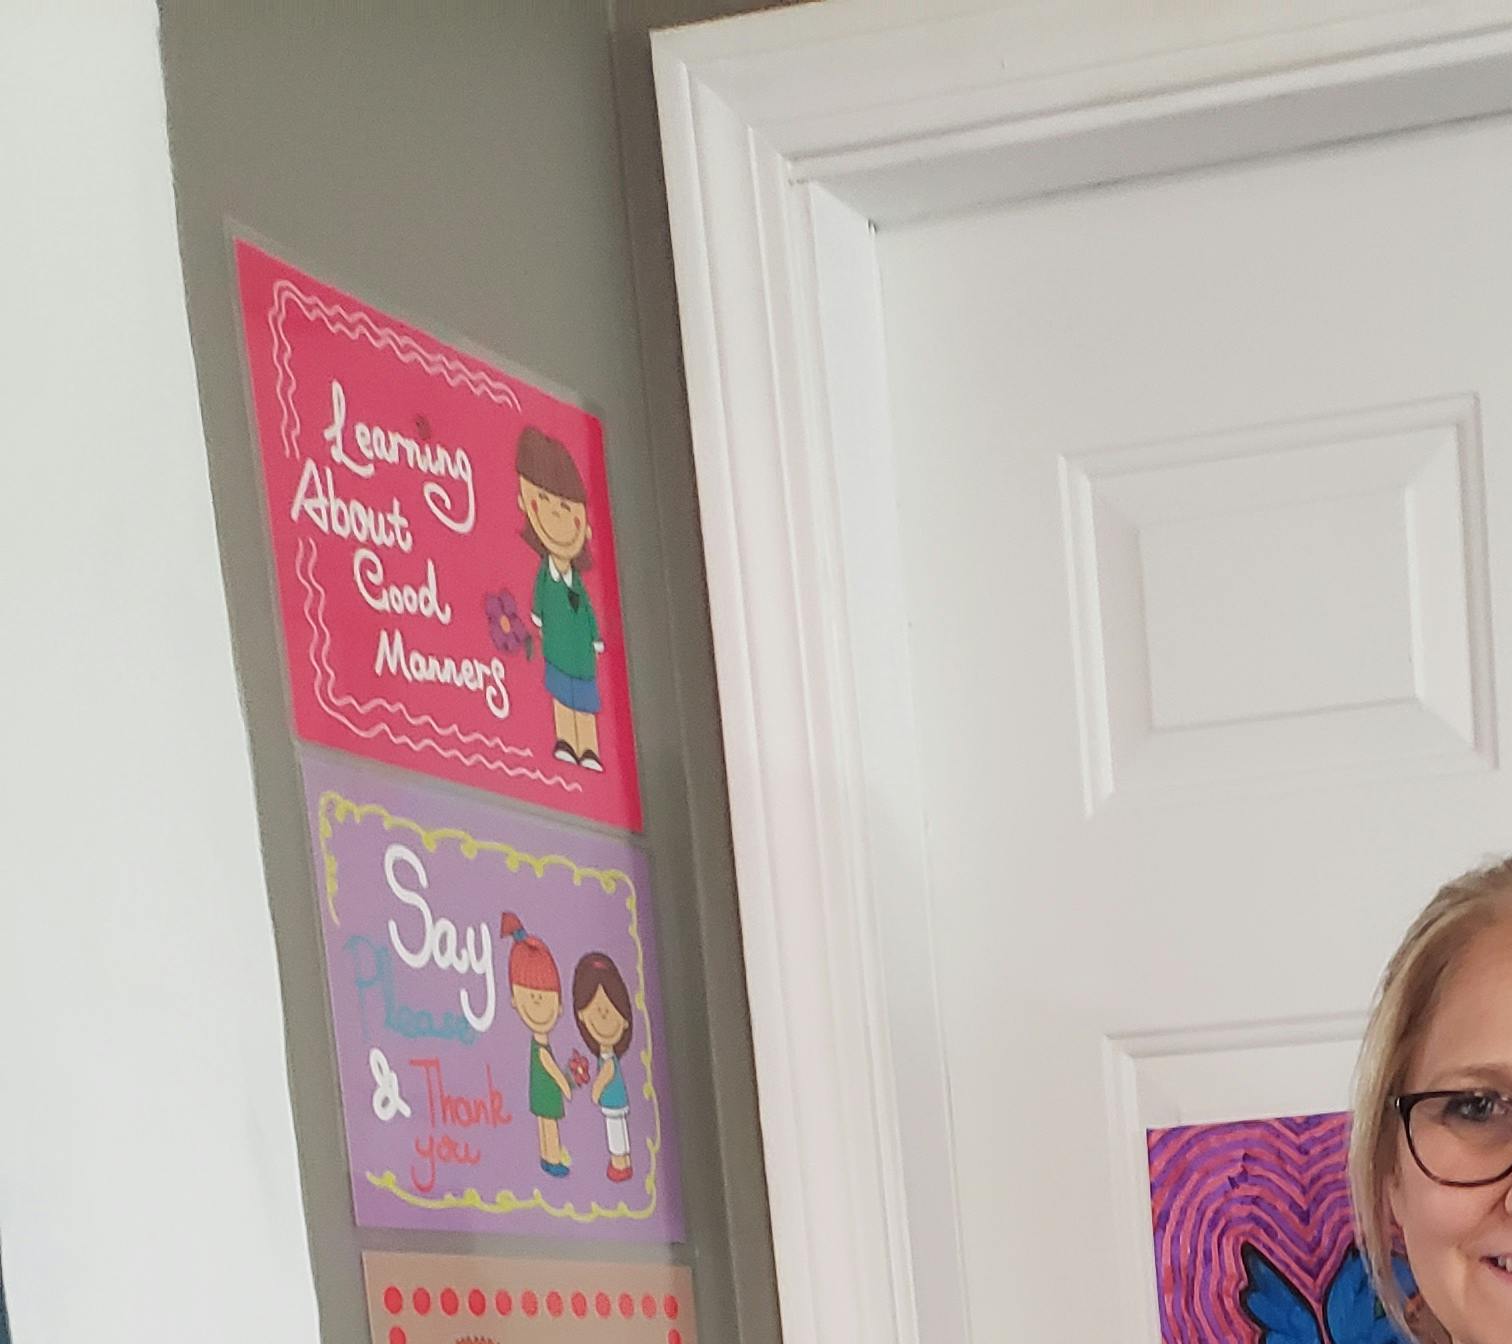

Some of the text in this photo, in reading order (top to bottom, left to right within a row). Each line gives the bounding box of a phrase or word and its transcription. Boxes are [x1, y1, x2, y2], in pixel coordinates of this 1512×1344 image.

[324, 378, 475, 533] Learning
[291, 457, 413, 553] About
[353, 548, 452, 625] Good
[374, 628, 510, 719] Manners
[384, 844, 496, 1032] Say
[368, 1047, 411, 1122] &
[409, 1057, 512, 1130] Thank
[411, 1130, 481, 1193] you
